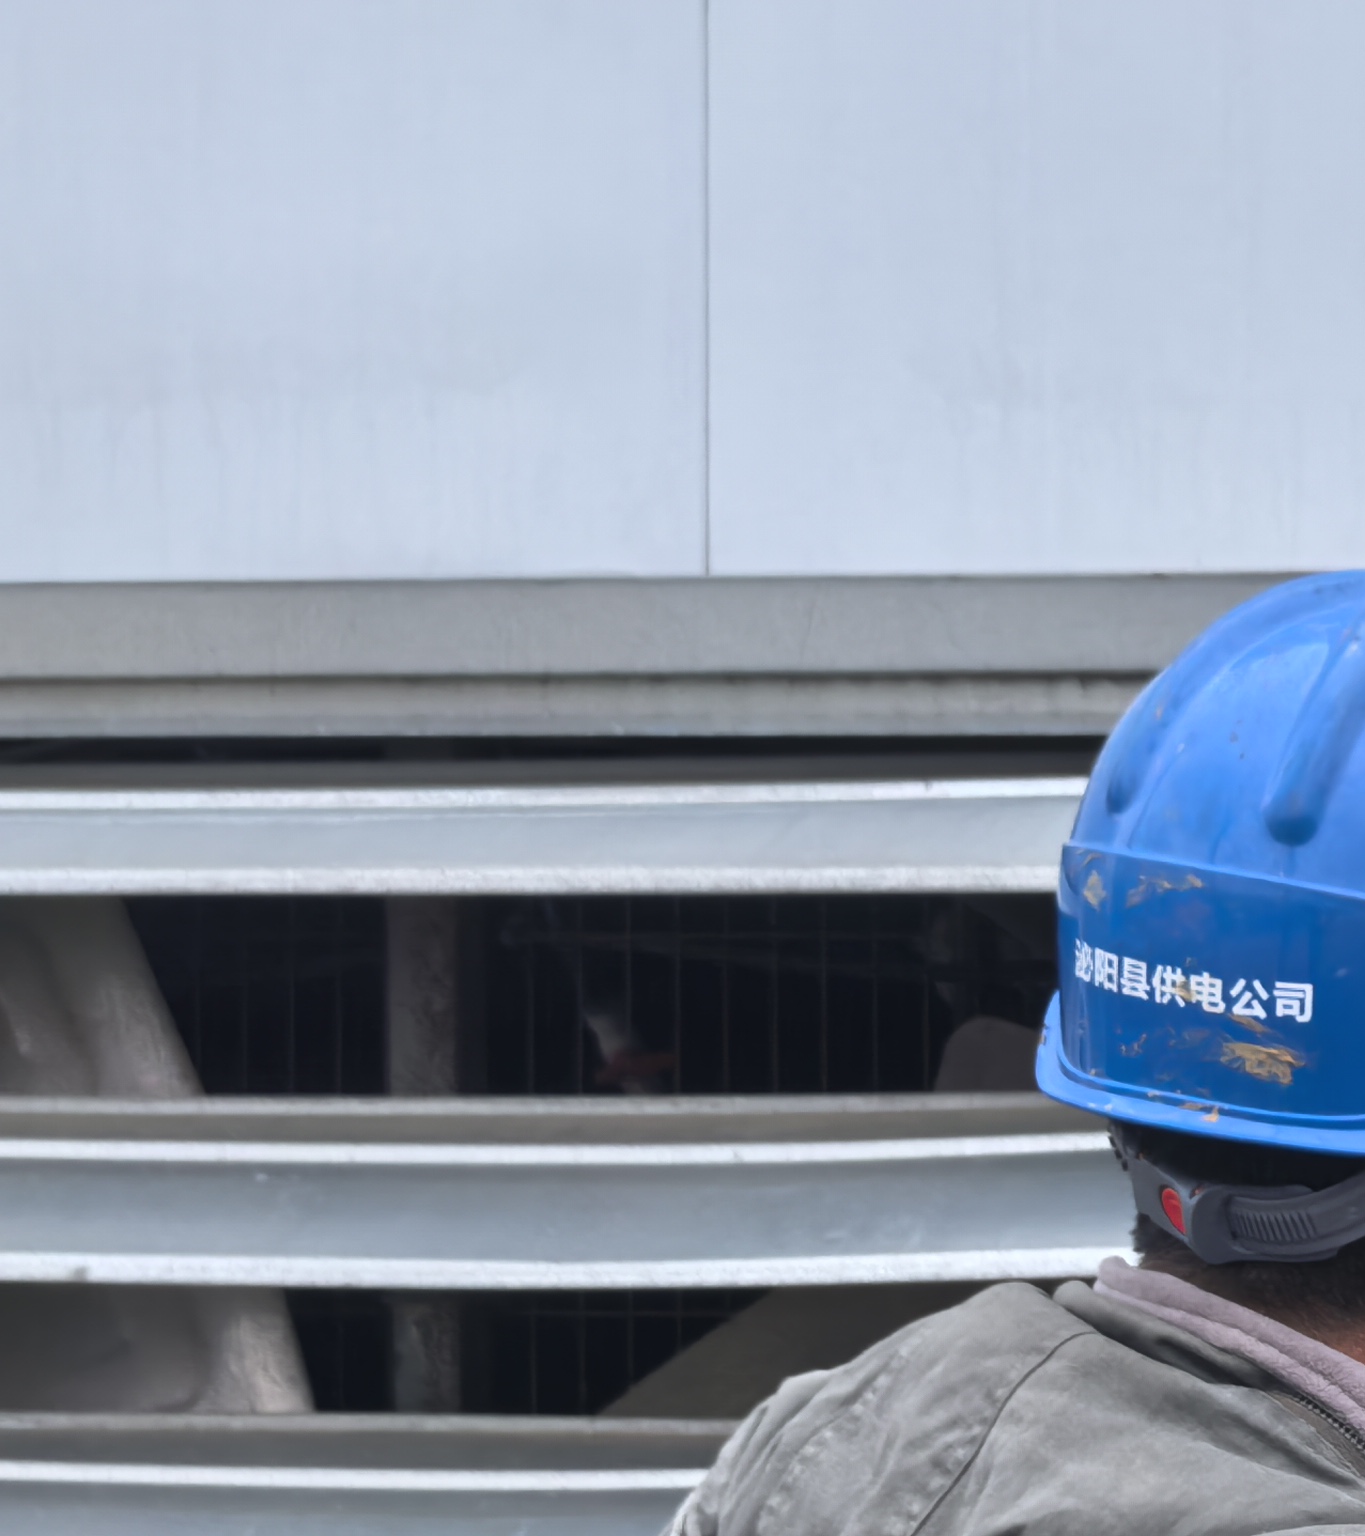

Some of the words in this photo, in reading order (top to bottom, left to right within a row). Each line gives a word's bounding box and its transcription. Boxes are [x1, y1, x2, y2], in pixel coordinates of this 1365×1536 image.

[1074, 937, 1314, 1024] 泌阳县供电公司
